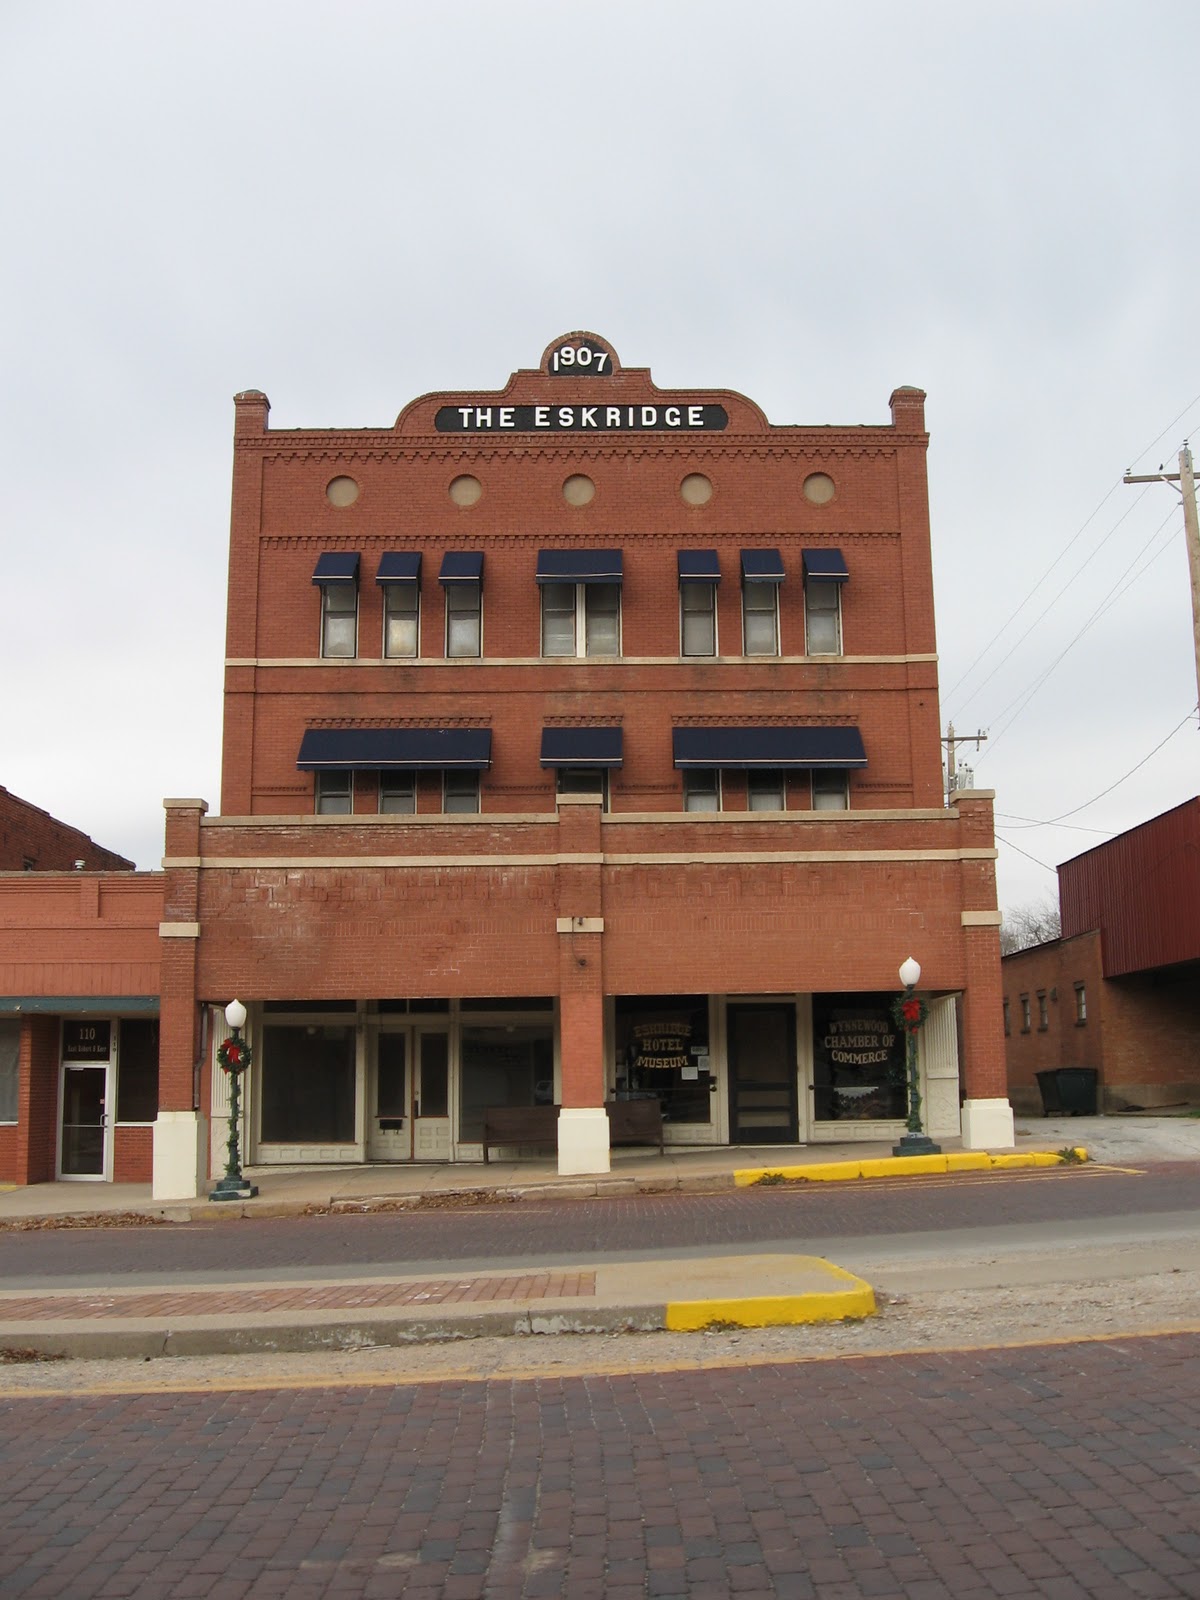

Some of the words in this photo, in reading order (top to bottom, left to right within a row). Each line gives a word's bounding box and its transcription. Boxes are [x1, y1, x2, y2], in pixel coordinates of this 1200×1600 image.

[553, 346, 608, 372] 1907
[458, 407, 515, 428] THE
[535, 406, 704, 428] ESKRIDGE
[79, 1028, 96, 1040] 110
[824, 1035, 879, 1048] CHAMBER
[882, 1034, 896, 1047] OF
[642, 1039, 683, 1051] HOTEL
[637, 1056, 689, 1068] MUSEUM
[831, 1050, 888, 1064] COMMERCE
